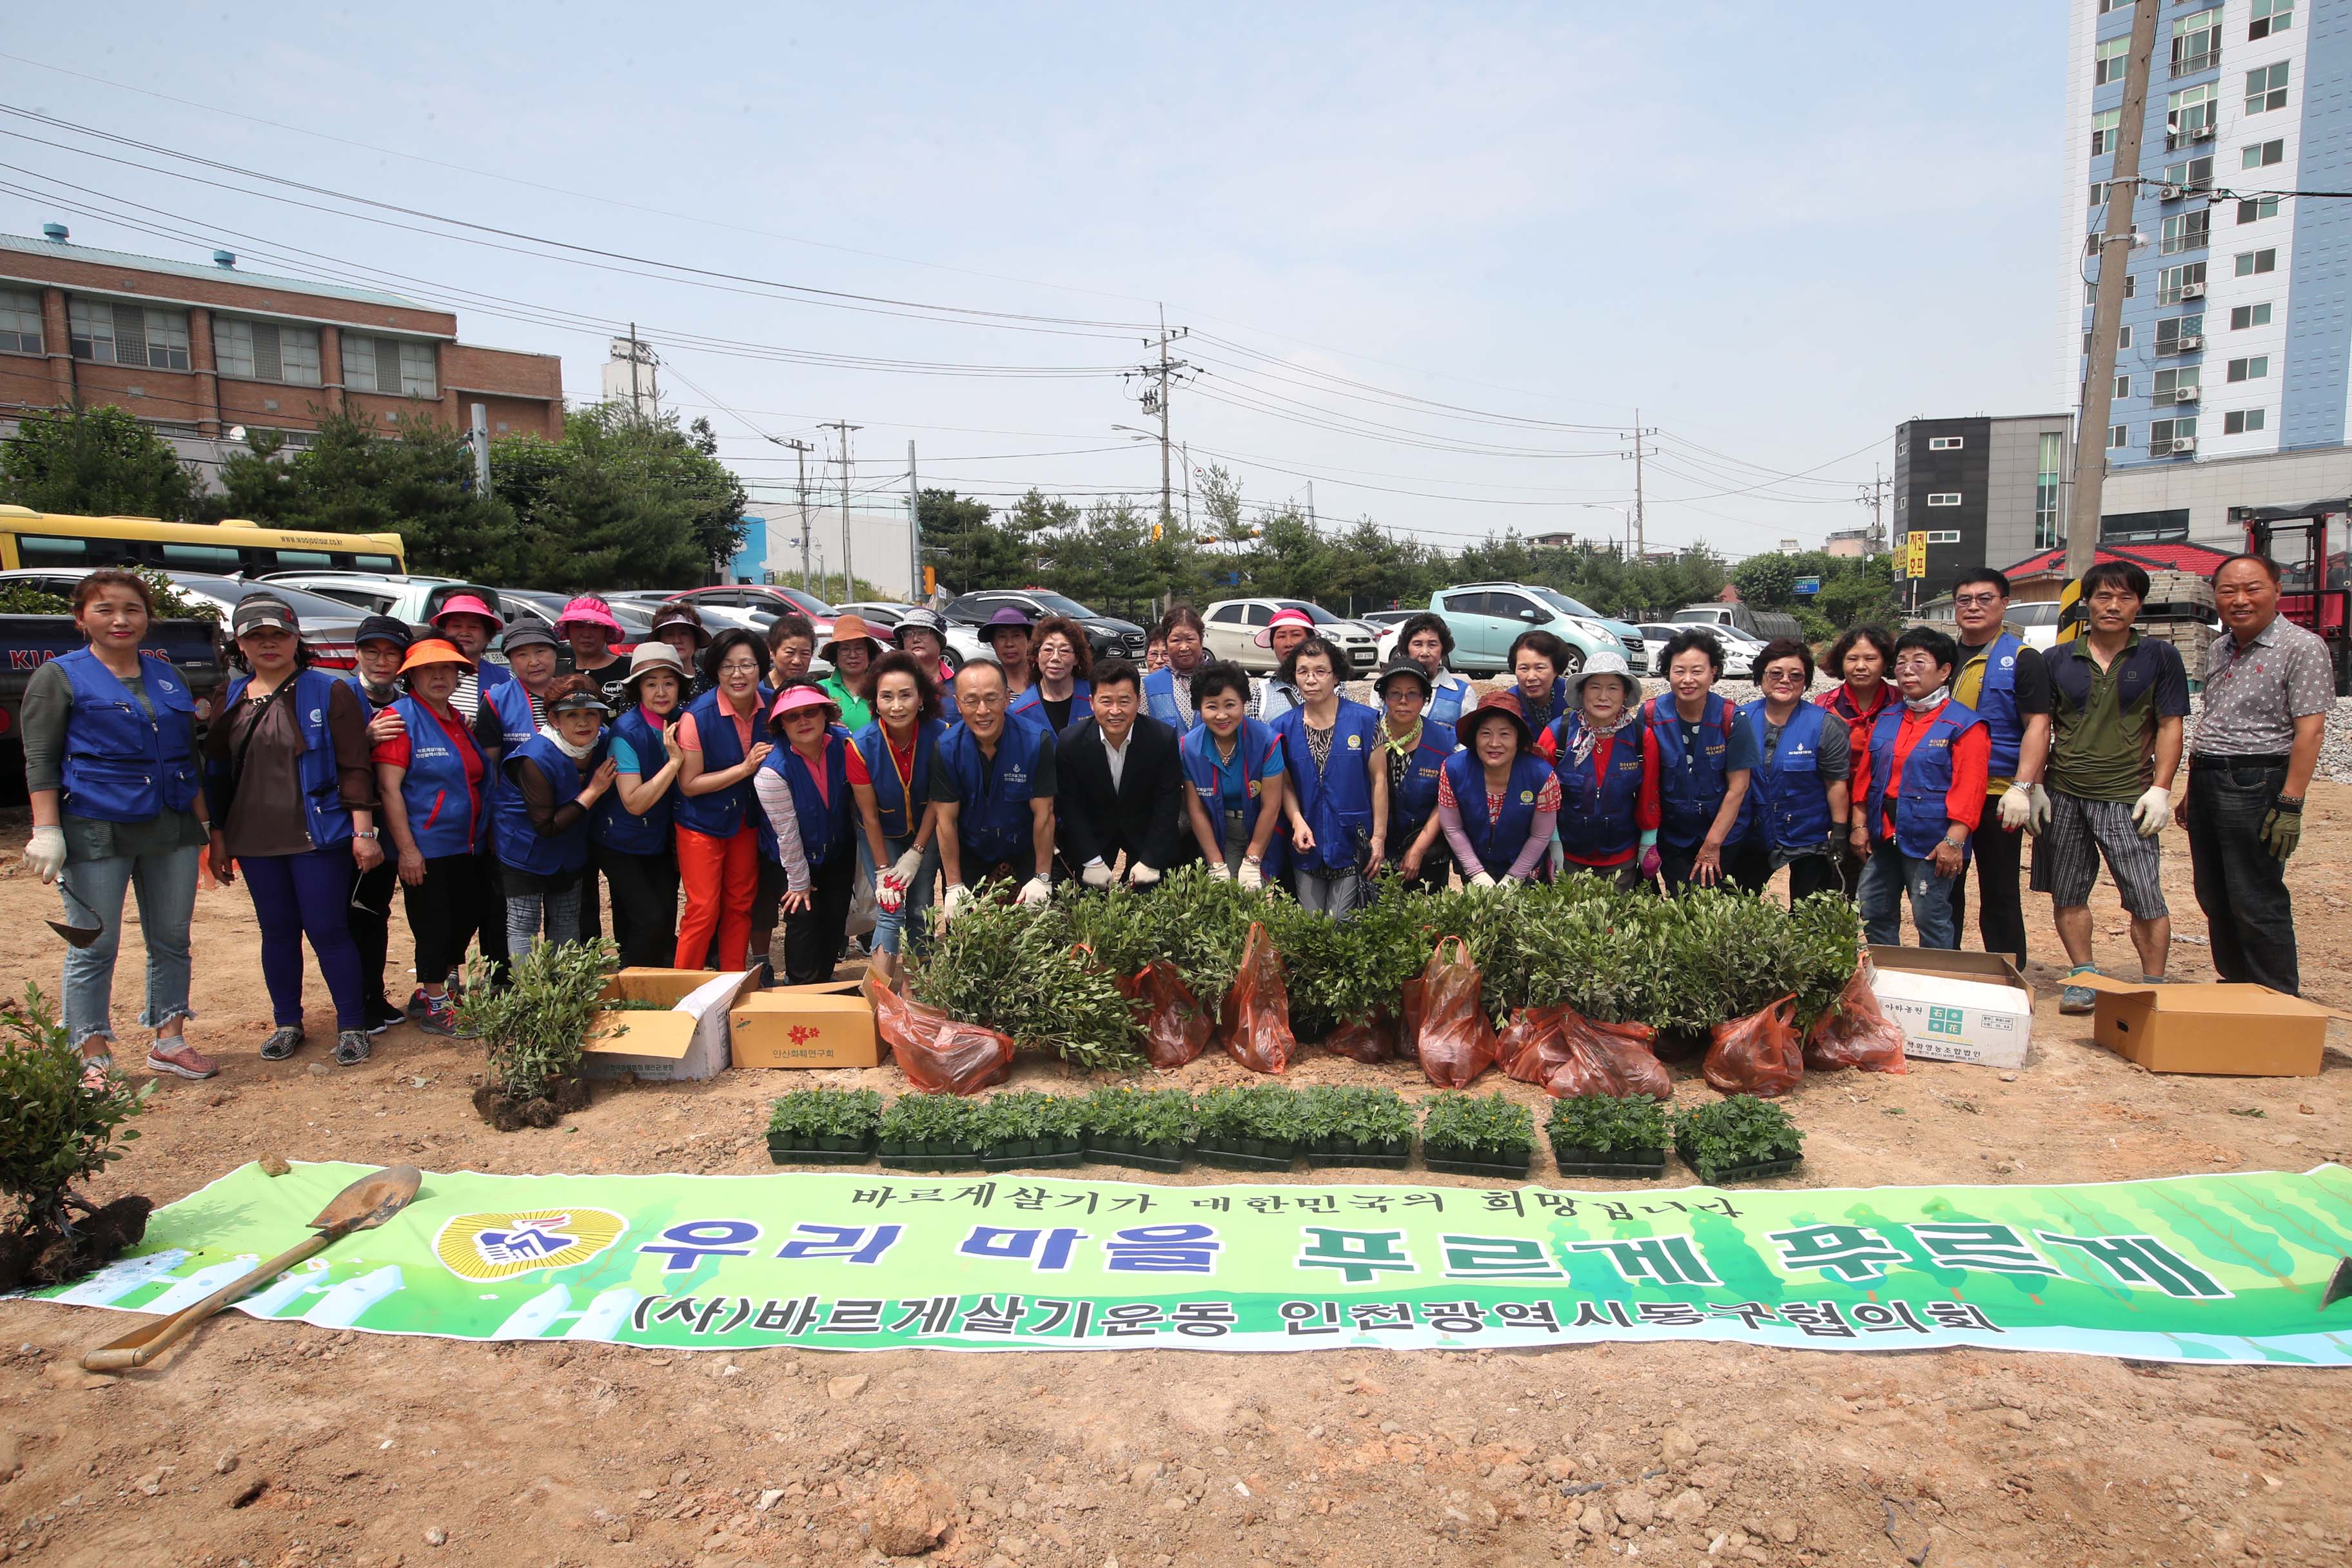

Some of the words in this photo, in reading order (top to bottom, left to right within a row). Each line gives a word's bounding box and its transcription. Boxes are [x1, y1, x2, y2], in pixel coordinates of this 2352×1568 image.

[1910, 533, 1924, 551] 치킨
[1909, 558, 1923, 574] 호프
[852, 1182, 1157, 1215] 바르게살기가
[1190, 1191, 1444, 1215] 대한민국의
[644, 1220, 902, 1273] 우리
[960, 1224, 1220, 1273] 마을
[1298, 1227, 1720, 1284] 푸르게
[1770, 1224, 2228, 1297] 푸르게
[634, 1295, 1235, 1338] (사)바르게살기운동
